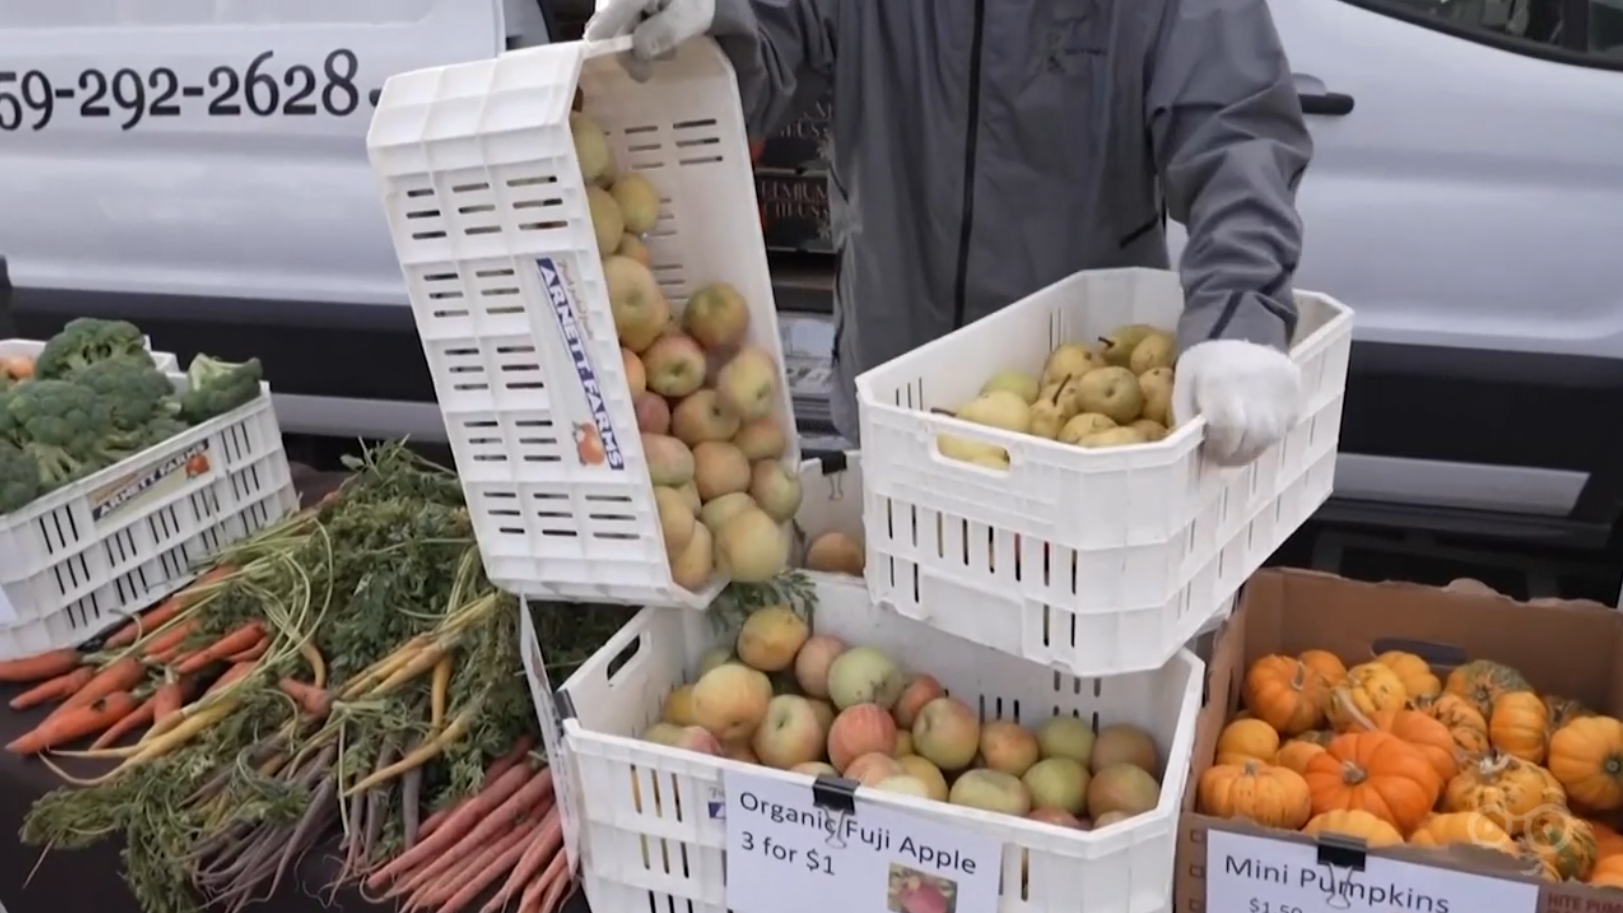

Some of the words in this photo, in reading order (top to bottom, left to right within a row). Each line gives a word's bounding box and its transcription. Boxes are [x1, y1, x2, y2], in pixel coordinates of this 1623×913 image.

[540, 265, 591, 373] ARNETT
[584, 376, 623, 467] FARMS
[740, 792, 836, 834] Organic
[846, 819, 890, 849] Fuji
[899, 837, 976, 874] Apple
[741, 831, 755, 851] 3
[764, 837, 798, 862] for
[806, 848, 835, 875] $1
[1225, 854, 1288, 885] Mini
[1300, 867, 1450, 913] Pumpkins
